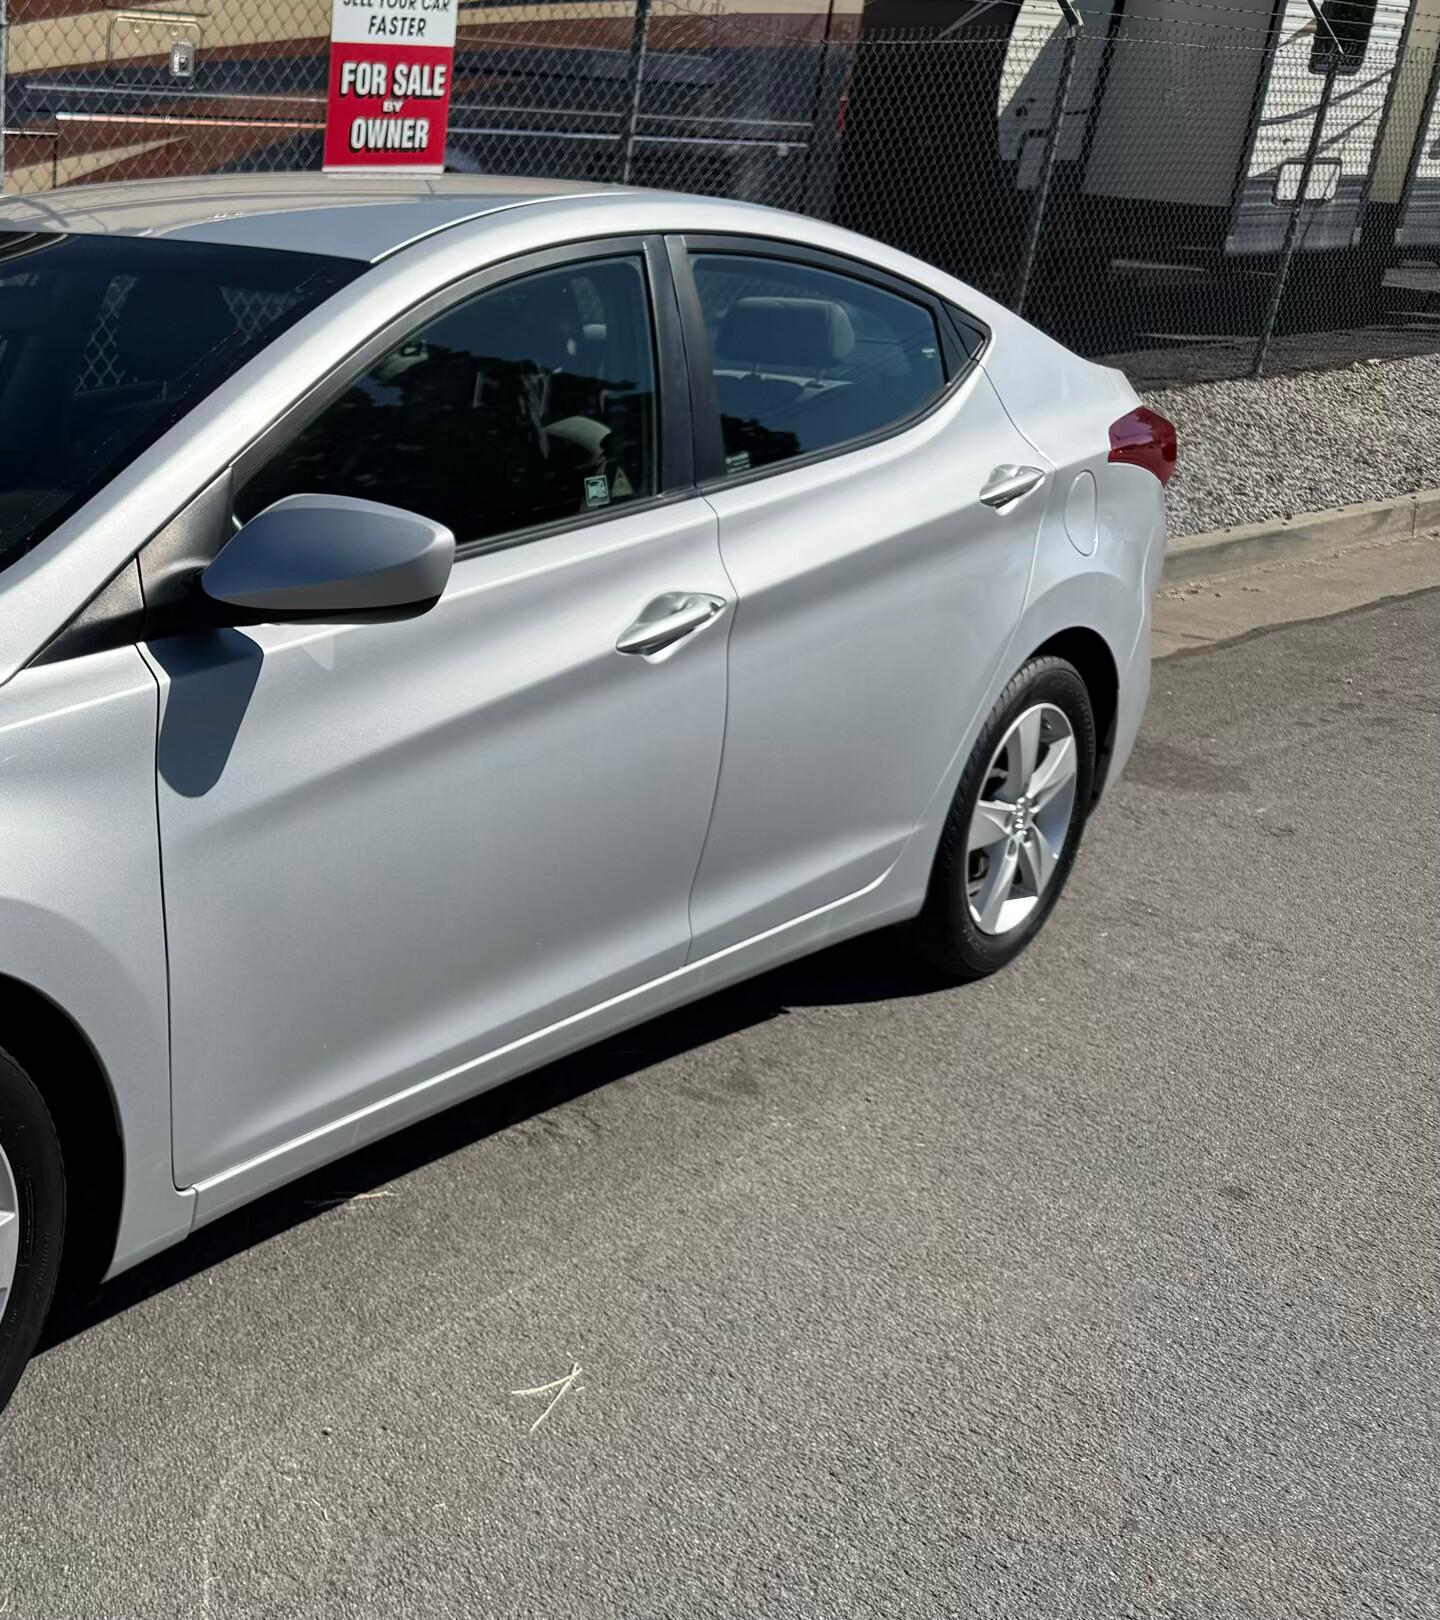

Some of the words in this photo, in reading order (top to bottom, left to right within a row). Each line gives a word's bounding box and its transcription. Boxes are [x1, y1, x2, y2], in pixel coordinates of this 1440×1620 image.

[368, 15, 427, 37] FASTER
[340, 61, 387, 97] FOR
[392, 62, 447, 98] SALE
[382, 100, 404, 113] BY
[350, 118, 430, 151] OWNER
